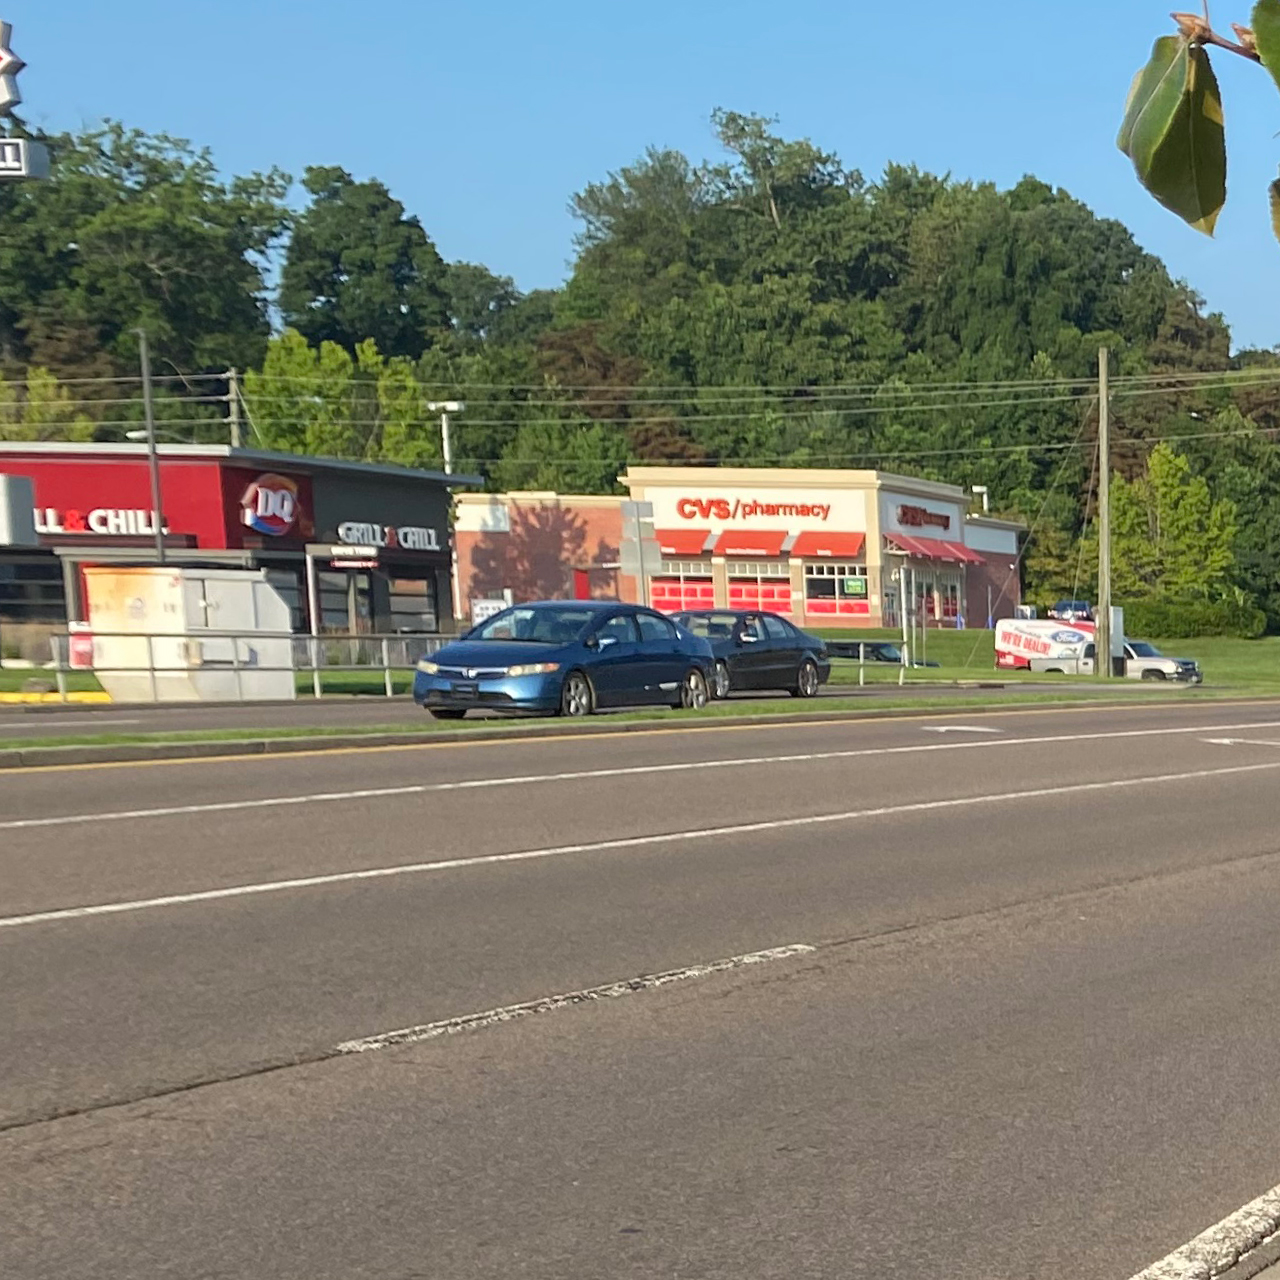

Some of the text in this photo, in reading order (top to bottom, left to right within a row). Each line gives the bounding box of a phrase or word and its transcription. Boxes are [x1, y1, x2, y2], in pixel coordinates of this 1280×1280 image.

[256, 486, 293, 523] DQ
[88, 509, 170, 536] CHILL
[338, 522, 385, 547] GRILL
[397, 526, 441, 552] CHILL
[1056, 632, 1079, 643] Ford
